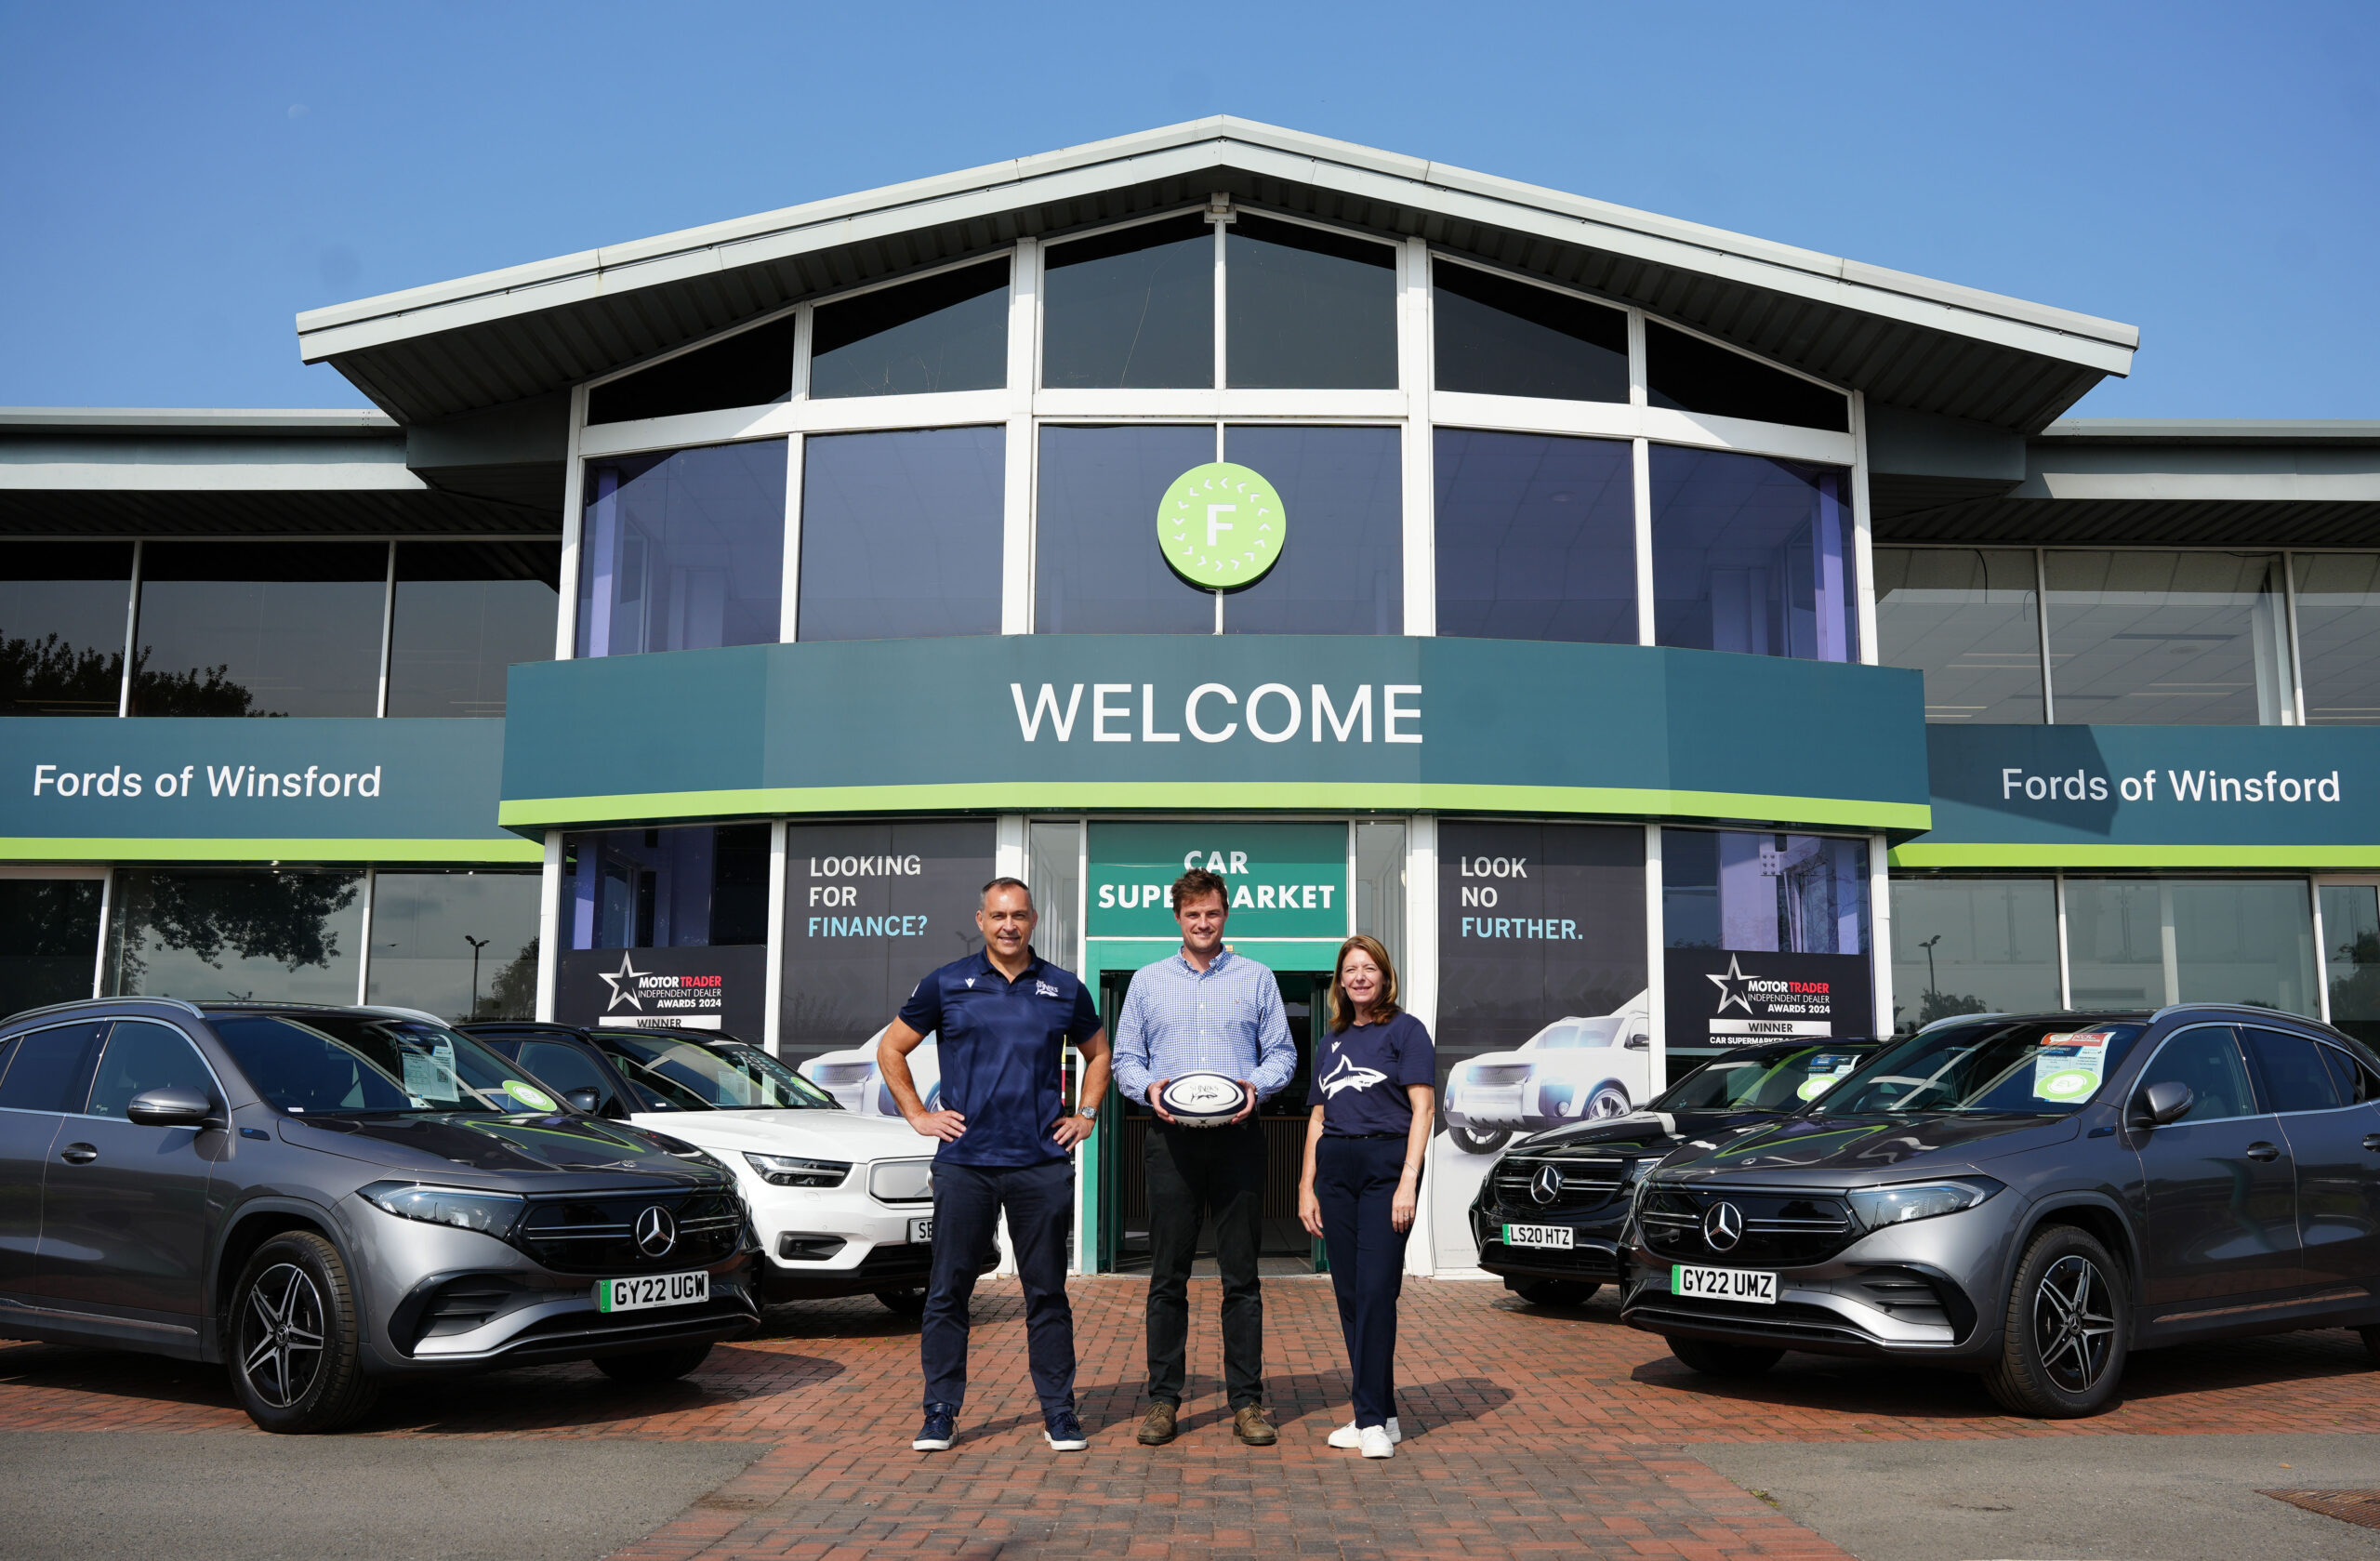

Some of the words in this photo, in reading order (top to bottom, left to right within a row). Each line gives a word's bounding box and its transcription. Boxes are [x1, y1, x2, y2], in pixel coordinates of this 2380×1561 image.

[1206, 503, 1236, 547] F
[1010, 682, 1423, 744] WELCOME
[33, 764, 142, 797] Fords
[154, 765, 193, 798] of
[206, 765, 381, 798] Winsford
[2003, 768, 2109, 800] Fords
[2120, 770, 2156, 801] of
[2168, 770, 2341, 802] Winsford
[810, 854, 921, 877] LOOKING
[1183, 850, 1249, 875] CAR
[1461, 855, 1527, 879] LOOK
[809, 886, 857, 907] FOR
[1098, 884, 1335, 908] SUPEARKET
[1461, 886, 1498, 907] NO
[808, 915, 928, 938] FINANCE?
[1461, 917, 1583, 940] FURTHER.
[638, 976, 680, 988] MOTOR
[681, 975, 721, 987] TRADER
[1748, 980, 1789, 993] MOTOR
[1789, 981, 1830, 994] TRADER
[638, 988, 691, 999] INDEPENDENT
[694, 988, 721, 998] DEALER
[656, 999, 696, 1009] AWARDS
[698, 999, 721, 1008] 2024
[1747, 993, 1801, 1003] INDEPENDENT
[1803, 994, 1831, 1004] DEALER
[1767, 1004, 1806, 1013] AWARDS
[1808, 1004, 1831, 1014] 2024
[637, 1018, 681, 1028] WINNER
[1748, 1023, 1793, 1033] WINNER
[1710, 1036, 1726, 1044] CAR
[1510, 1226, 1542, 1243] LS20
[1545, 1227, 1570, 1246] HTZ
[615, 1277, 667, 1305] GY22
[671, 1274, 705, 1300] UGW
[1683, 1268, 1729, 1295] GY22
[1734, 1273, 1774, 1299] UMZ
